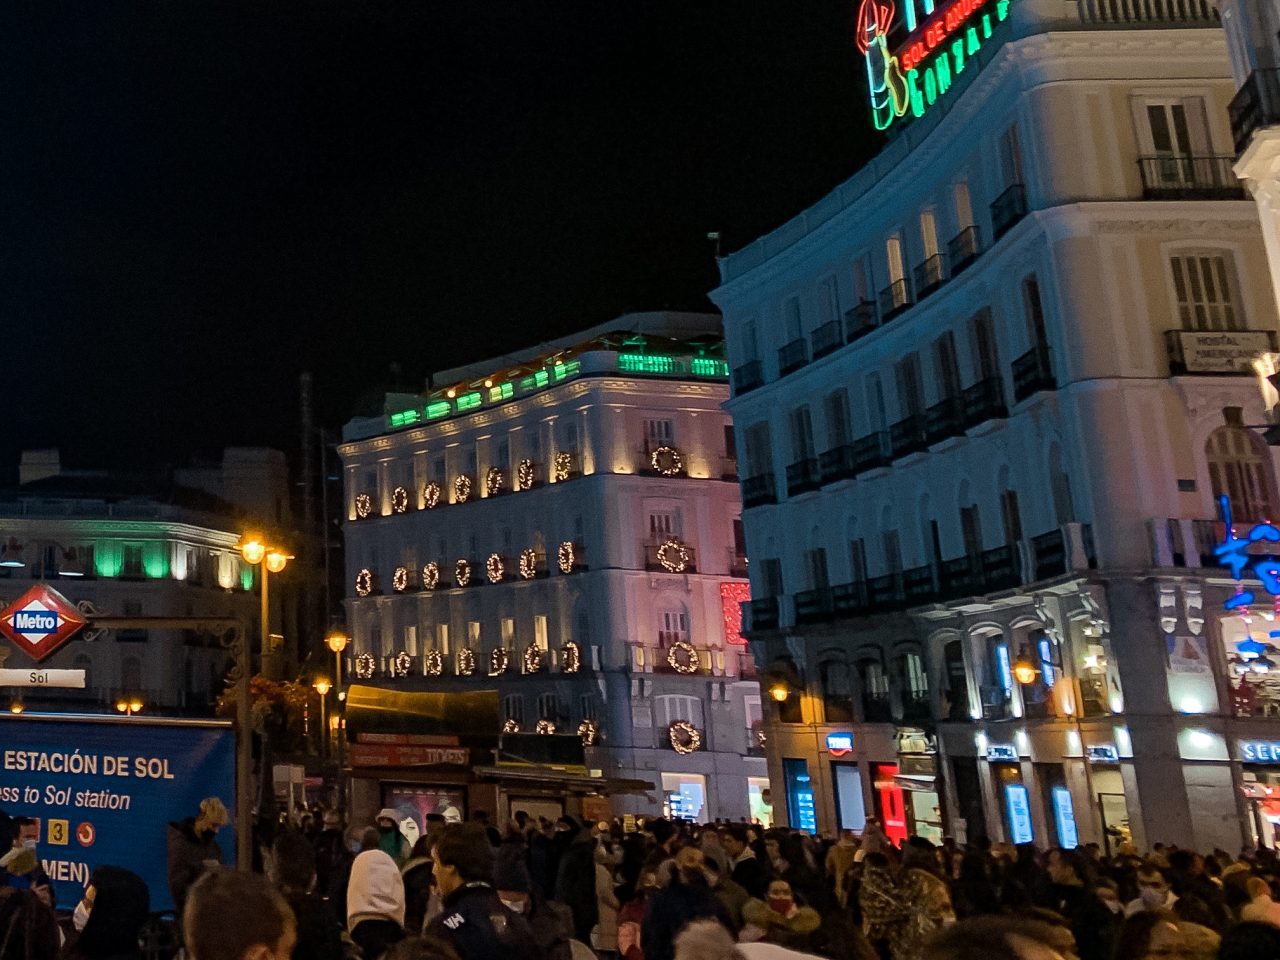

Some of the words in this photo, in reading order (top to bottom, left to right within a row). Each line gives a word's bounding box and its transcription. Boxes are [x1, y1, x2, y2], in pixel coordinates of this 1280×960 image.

[902, 42, 928, 70] SOL
[925, 21, 946, 48] DE
[15, 613, 55, 629] Metro
[29, 672, 48, 684] Sol
[4, 748, 97, 775] ESTACIÓN
[103, 755, 130, 777] DE
[135, 757, 174, 779] SOL
[24, 785, 40, 804] to
[44, 784, 71, 806] Sol
[75, 788, 130, 810] station
[53, 822, 63, 842] 3
